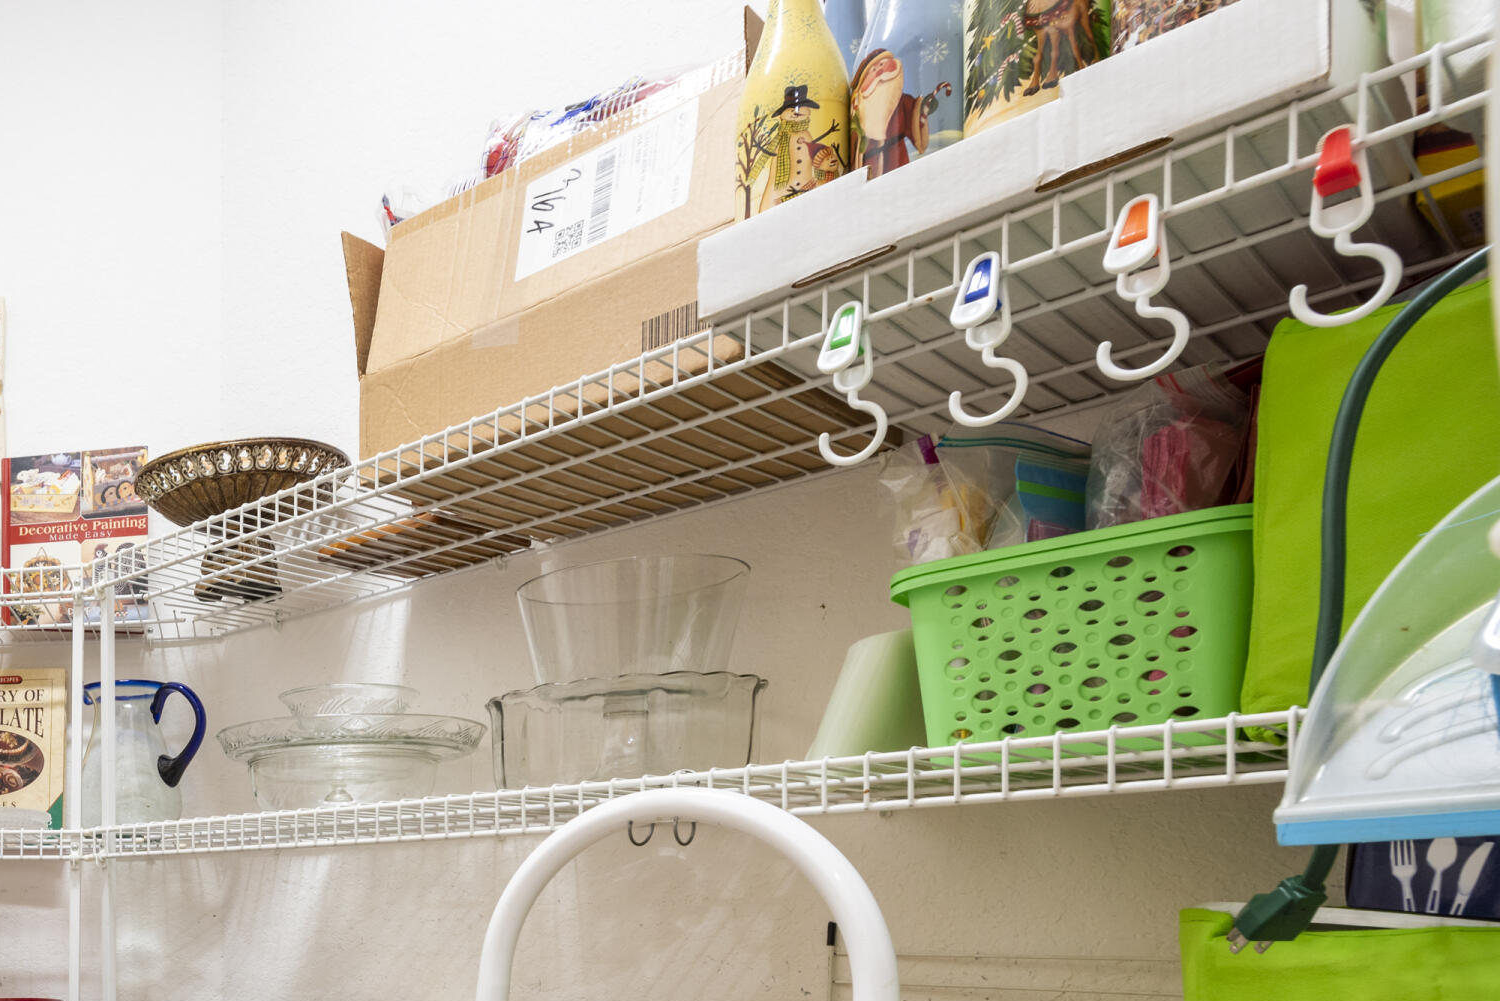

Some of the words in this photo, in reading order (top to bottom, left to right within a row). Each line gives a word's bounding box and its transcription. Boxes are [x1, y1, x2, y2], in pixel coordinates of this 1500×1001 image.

[18, 521, 89, 537] Decorative
[92, 517, 147, 531] Painting
[49, 533, 79, 541] Made
[84, 530, 113, 539] Easy
[24, 688, 45, 702] OF
